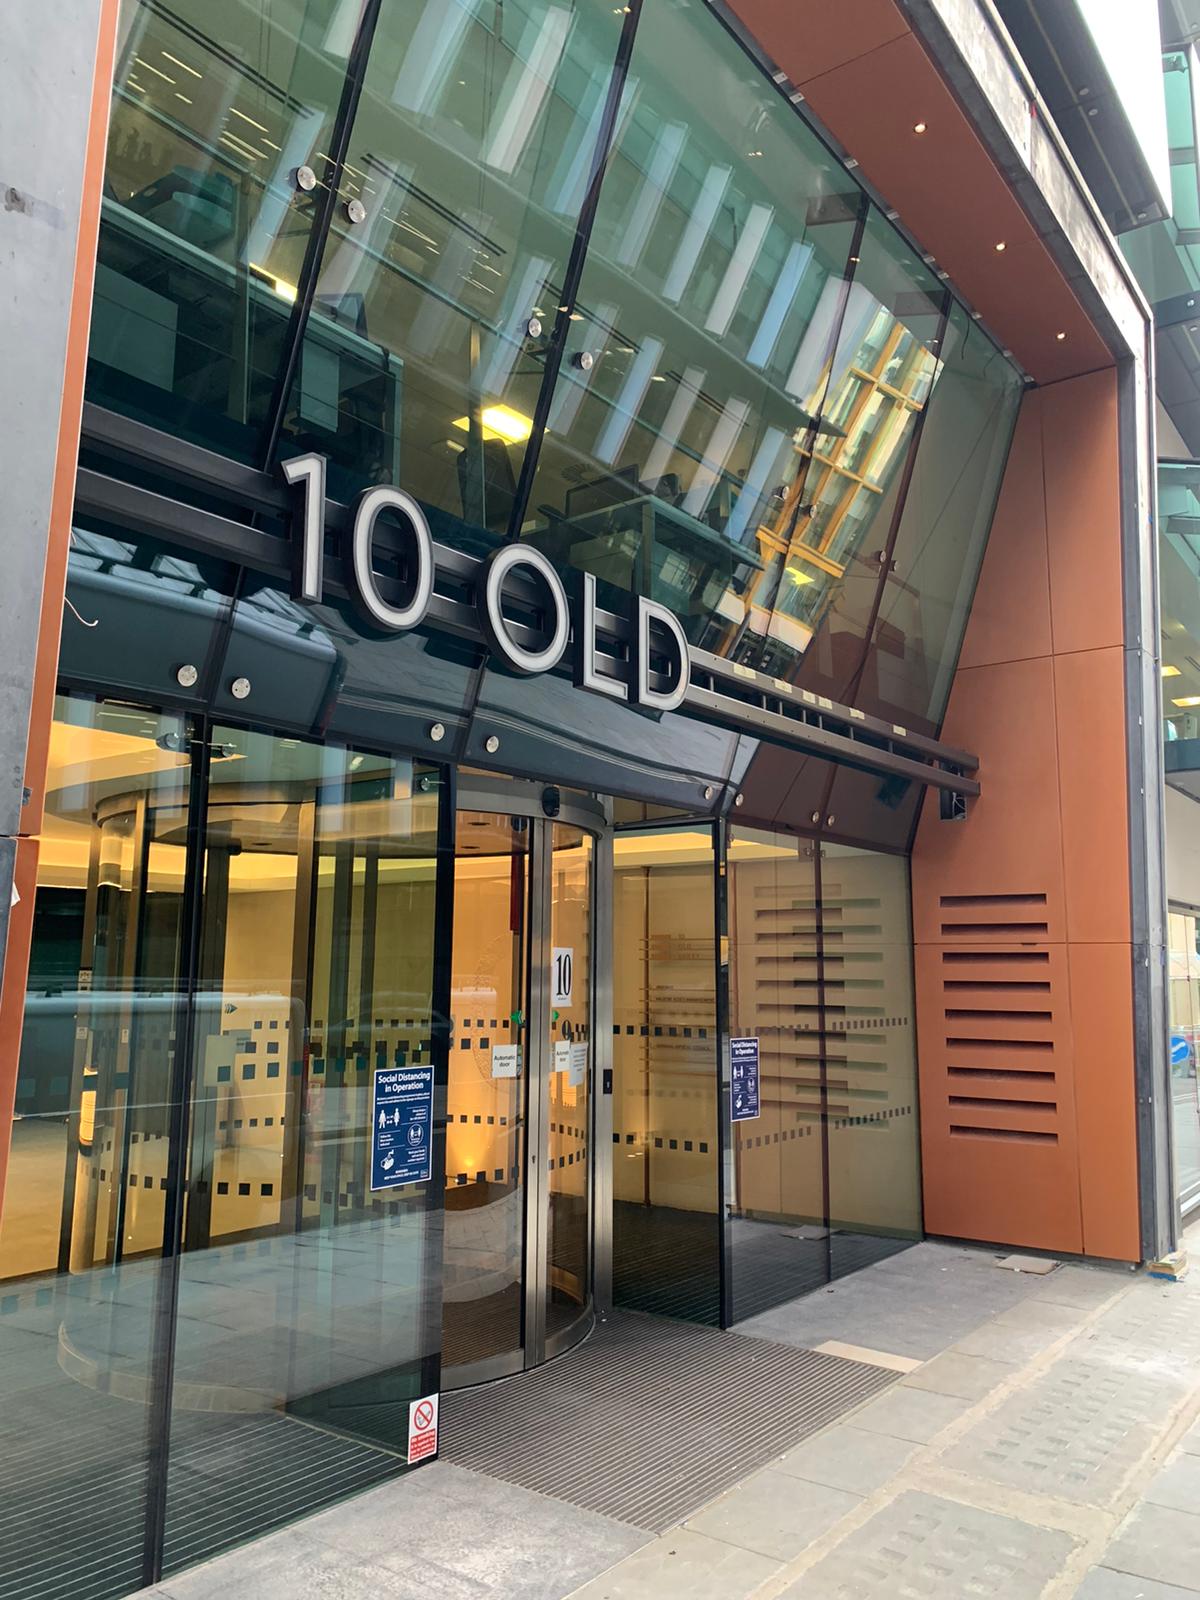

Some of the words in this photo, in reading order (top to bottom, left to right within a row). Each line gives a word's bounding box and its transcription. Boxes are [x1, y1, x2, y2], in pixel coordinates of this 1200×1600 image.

[281, 452, 434, 631] 10
[483, 543, 691, 712] OLD
[556, 954, 571, 996] 10
[378, 1073, 397, 1084] Social
[398, 1071, 431, 1082] Distancing
[384, 1084, 391, 1093] in
[392, 1082, 424, 1093] Operation
